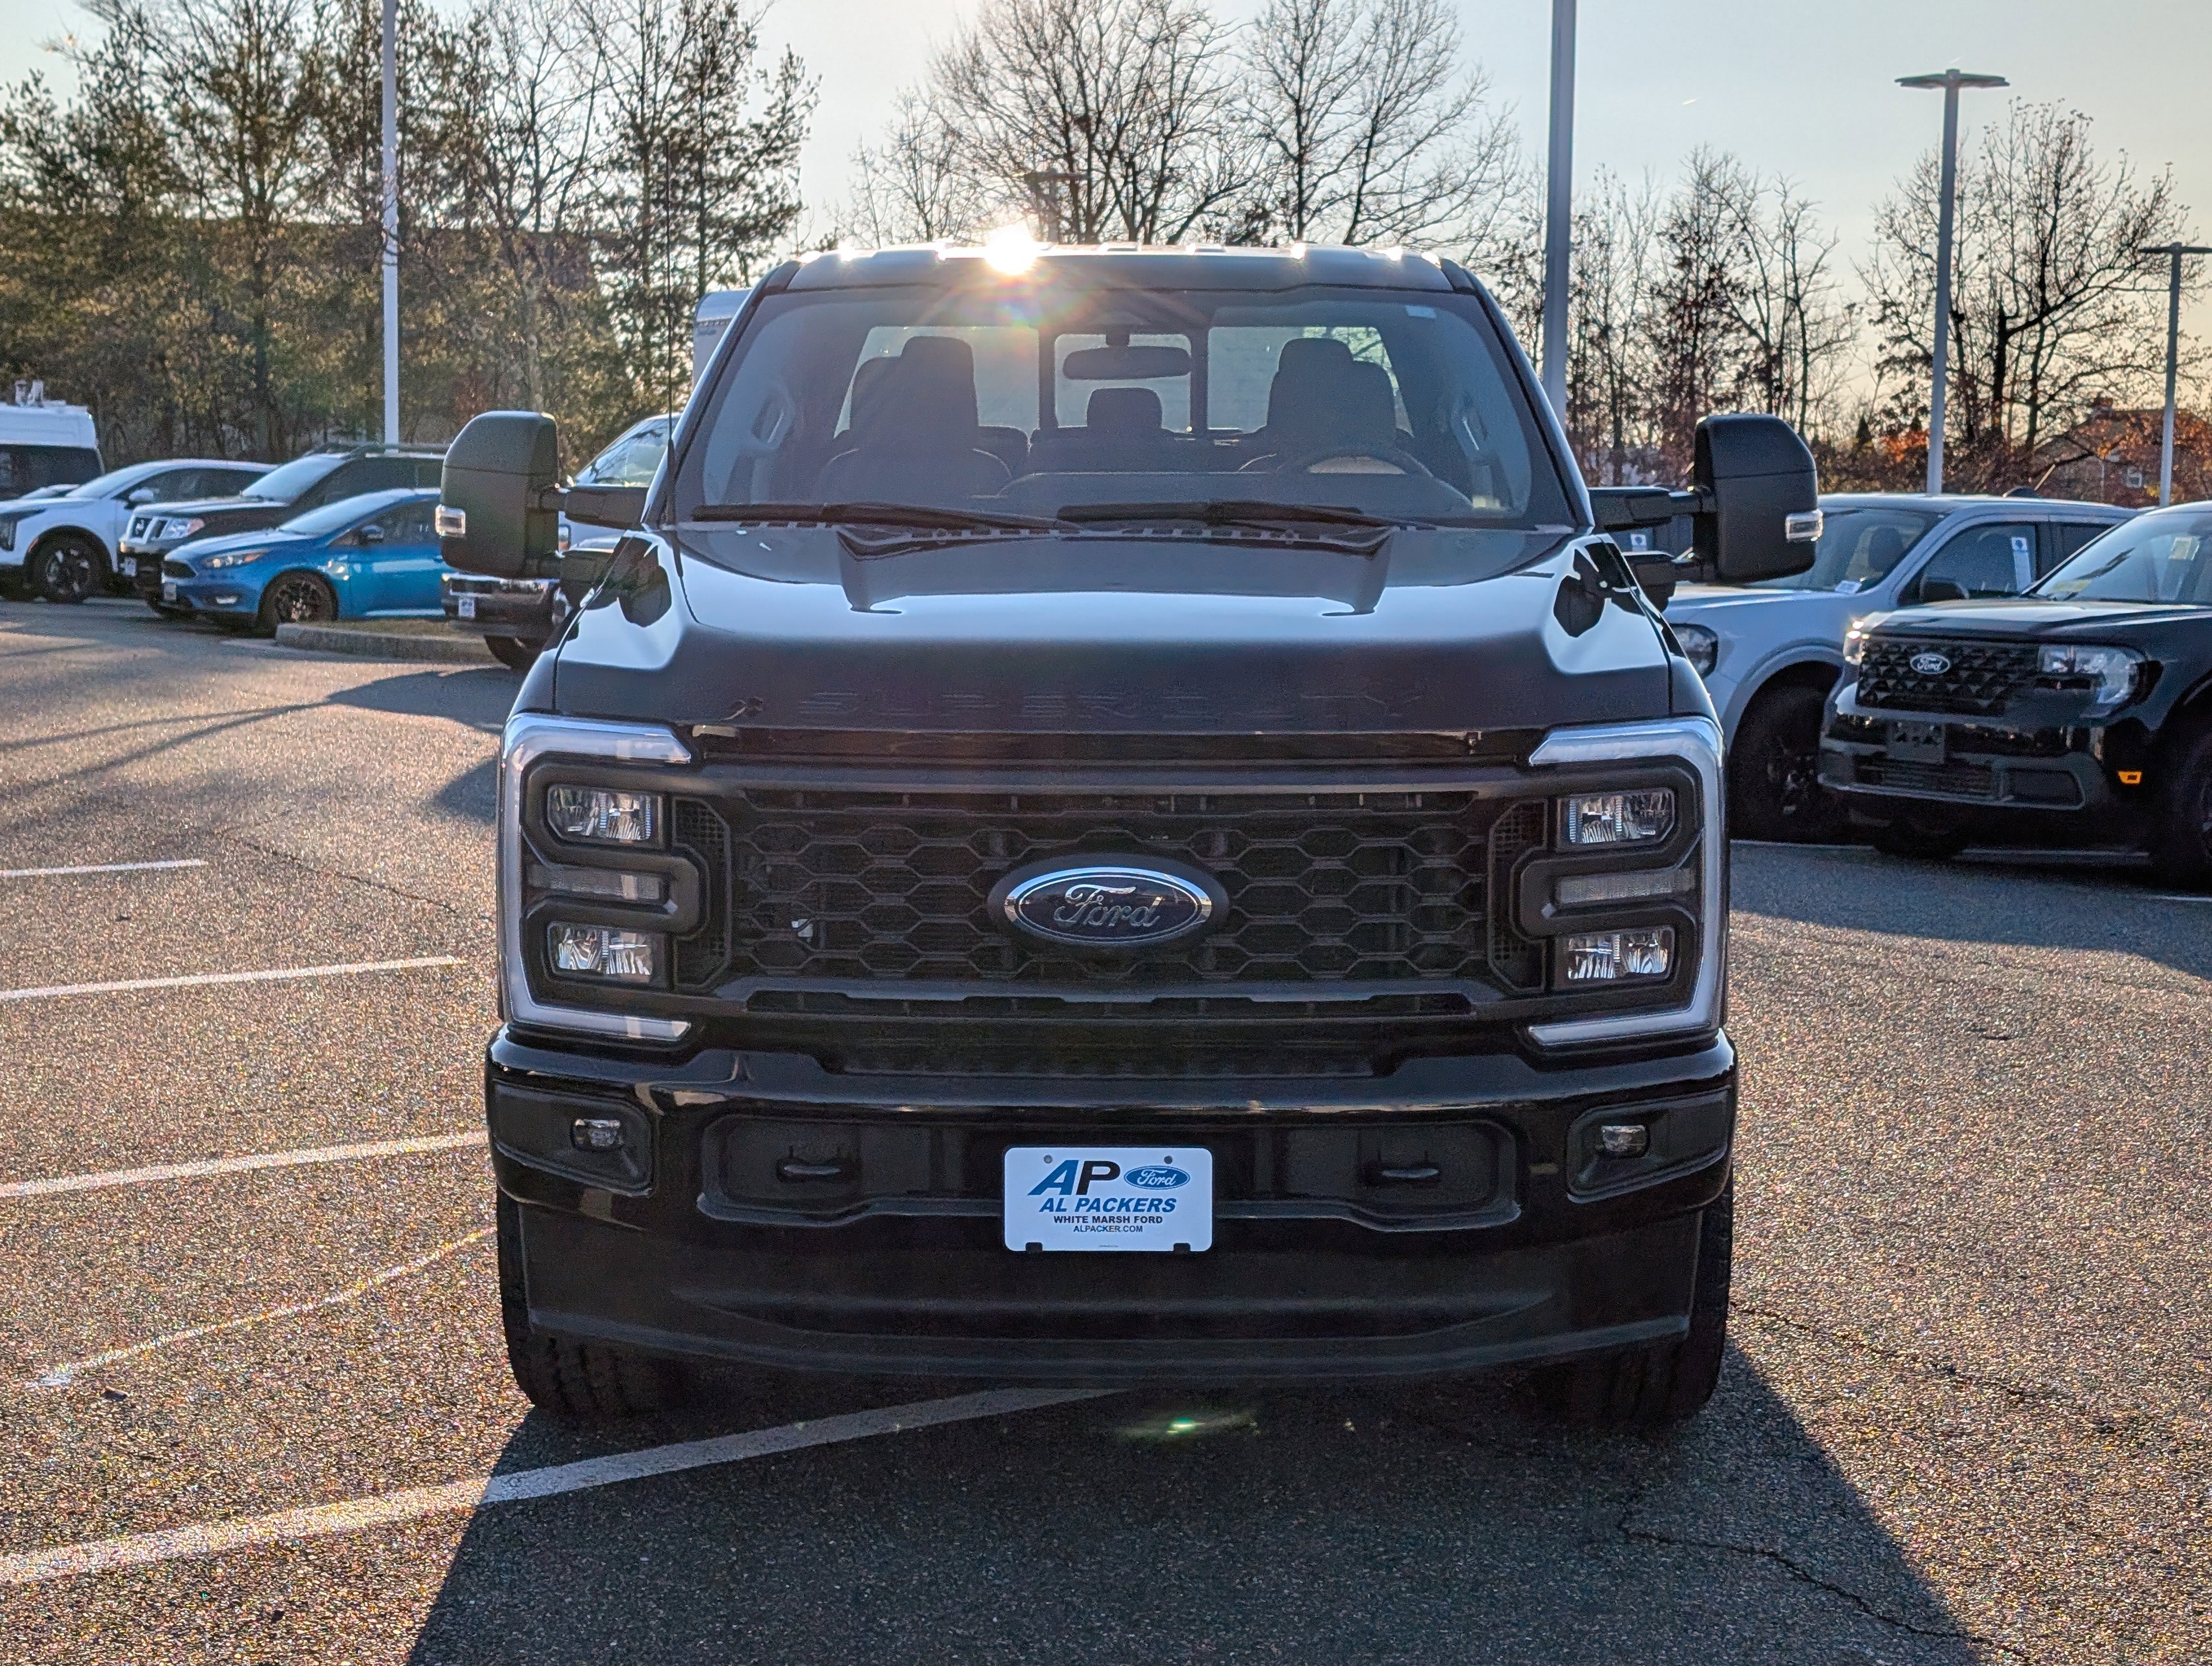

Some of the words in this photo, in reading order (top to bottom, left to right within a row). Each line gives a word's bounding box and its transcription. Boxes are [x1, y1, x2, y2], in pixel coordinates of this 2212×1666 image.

[1917, 656, 1943, 671] Ford
[1053, 883, 1161, 927] Ford
[1027, 1159, 1121, 1195] AP
[1137, 1169, 1177, 1186] Ford
[1039, 1197, 1066, 1213] AL
[1075, 1197, 1177, 1213] PACKERS
[1053, 1215, 1089, 1223] WHITE
[1092, 1215, 1130, 1223] MARSH
[1134, 1215, 1163, 1223] FORD
